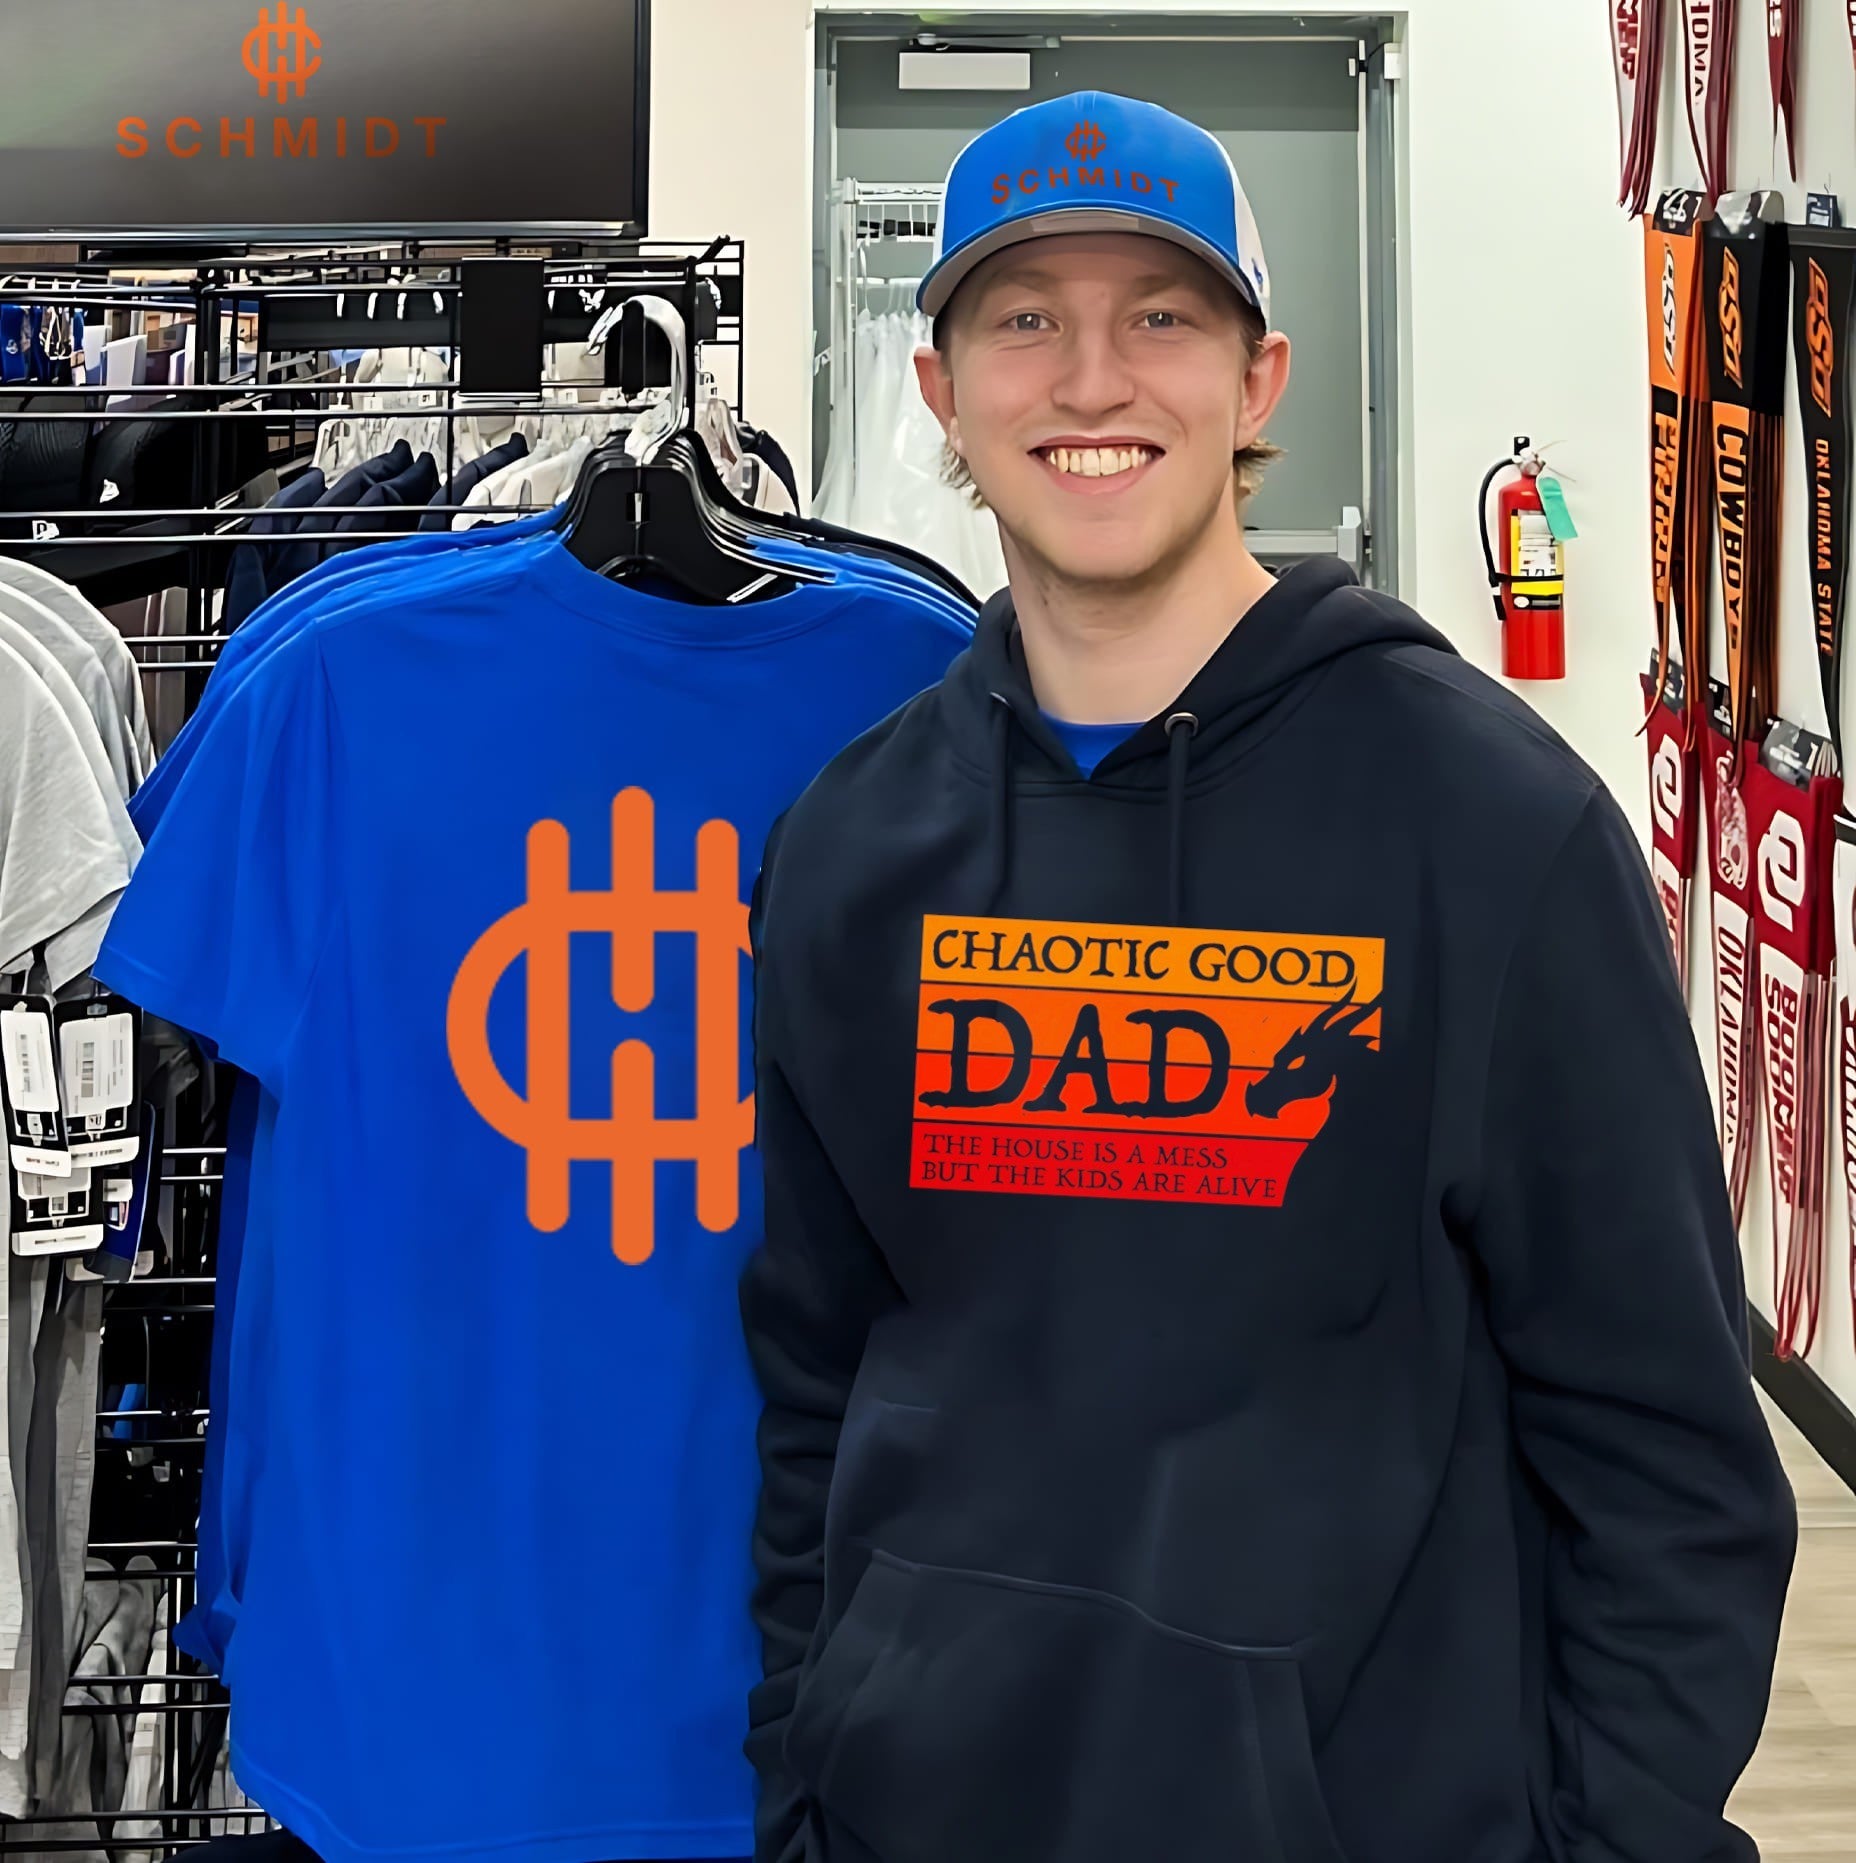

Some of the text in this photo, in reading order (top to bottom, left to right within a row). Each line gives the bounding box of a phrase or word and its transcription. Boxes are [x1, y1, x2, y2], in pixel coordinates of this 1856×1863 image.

[115, 116, 448, 159] SCHMIDT
[991, 167, 1179, 205] SCHMIDT
[933, 929, 1355, 988] CHAOTIC GOOD
[918, 998, 1231, 1119] DAD
[923, 1133, 1228, 1169] THE HOUSE IS A MESS
[922, 1161, 1278, 1198] BUT THE KIDS ARE ALIVE
